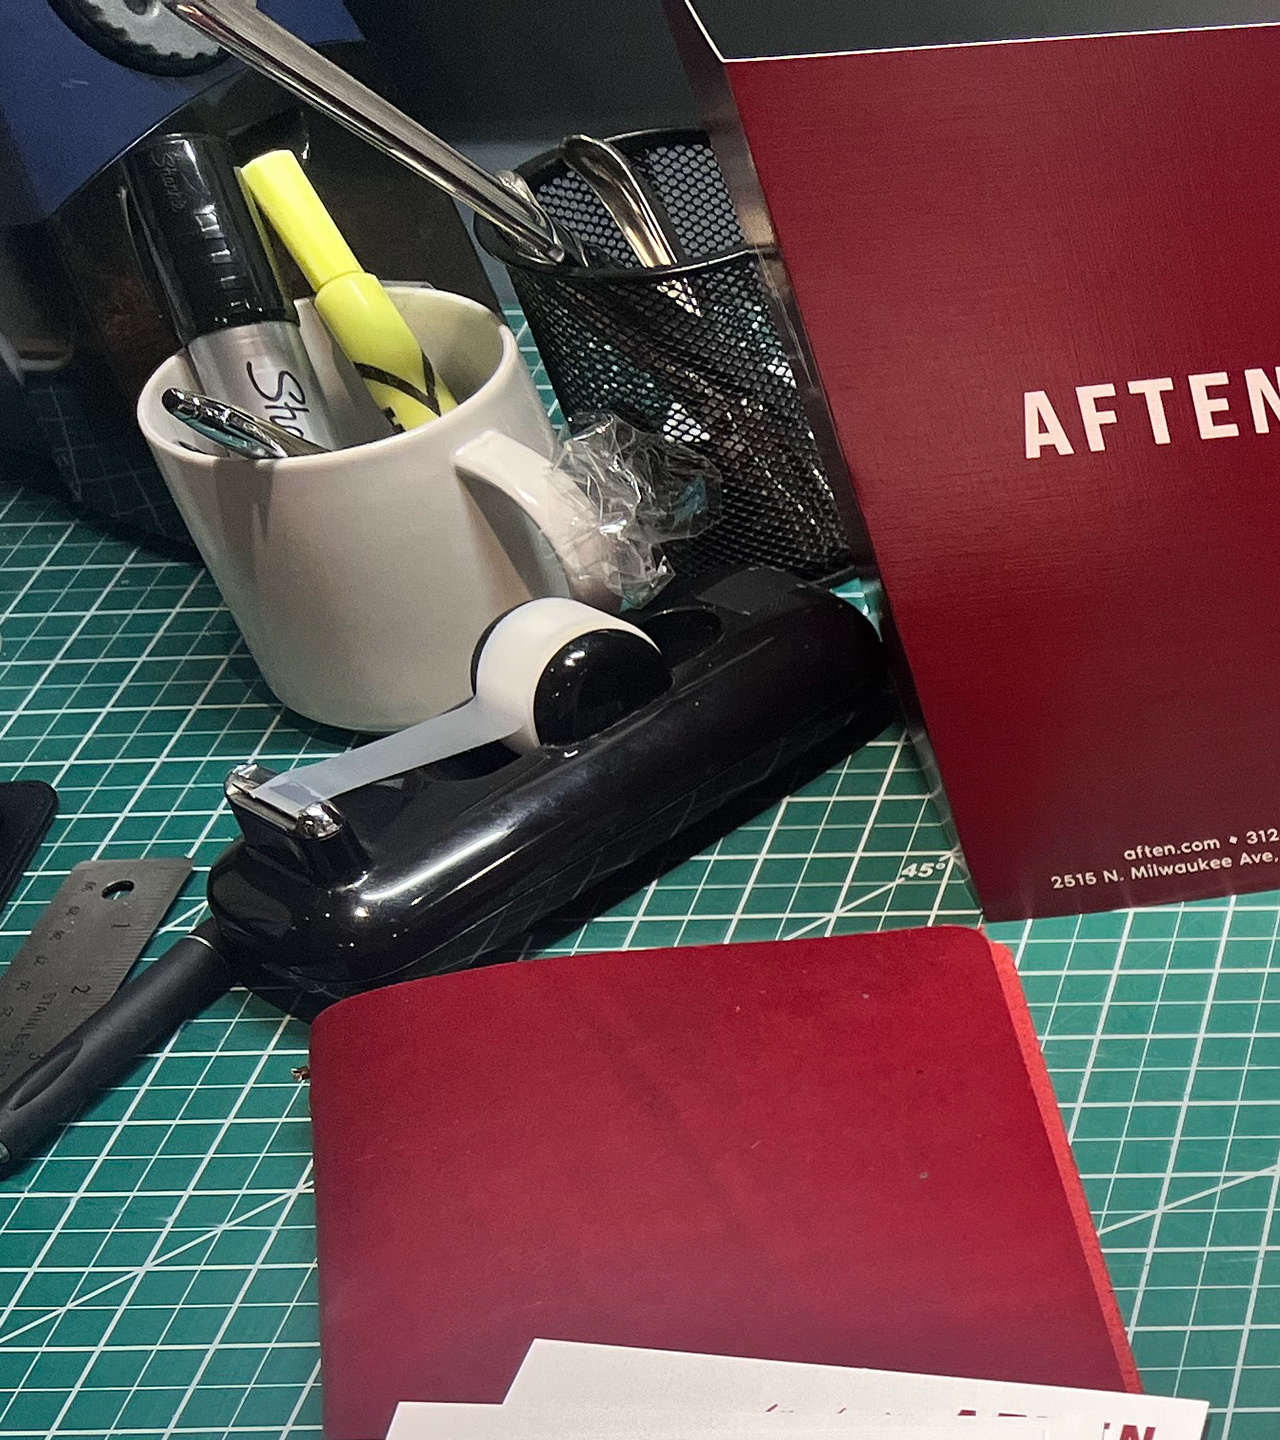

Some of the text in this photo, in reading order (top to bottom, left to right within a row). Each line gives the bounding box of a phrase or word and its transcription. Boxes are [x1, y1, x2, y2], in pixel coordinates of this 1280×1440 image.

[1124, 839, 1220, 860] aften.com
[1051, 872, 1096, 888] 2515
[1103, 869, 1124, 882] N.
[1131, 857, 1232, 879] Milwaukee
[1240, 852, 1278, 865] Ave,
